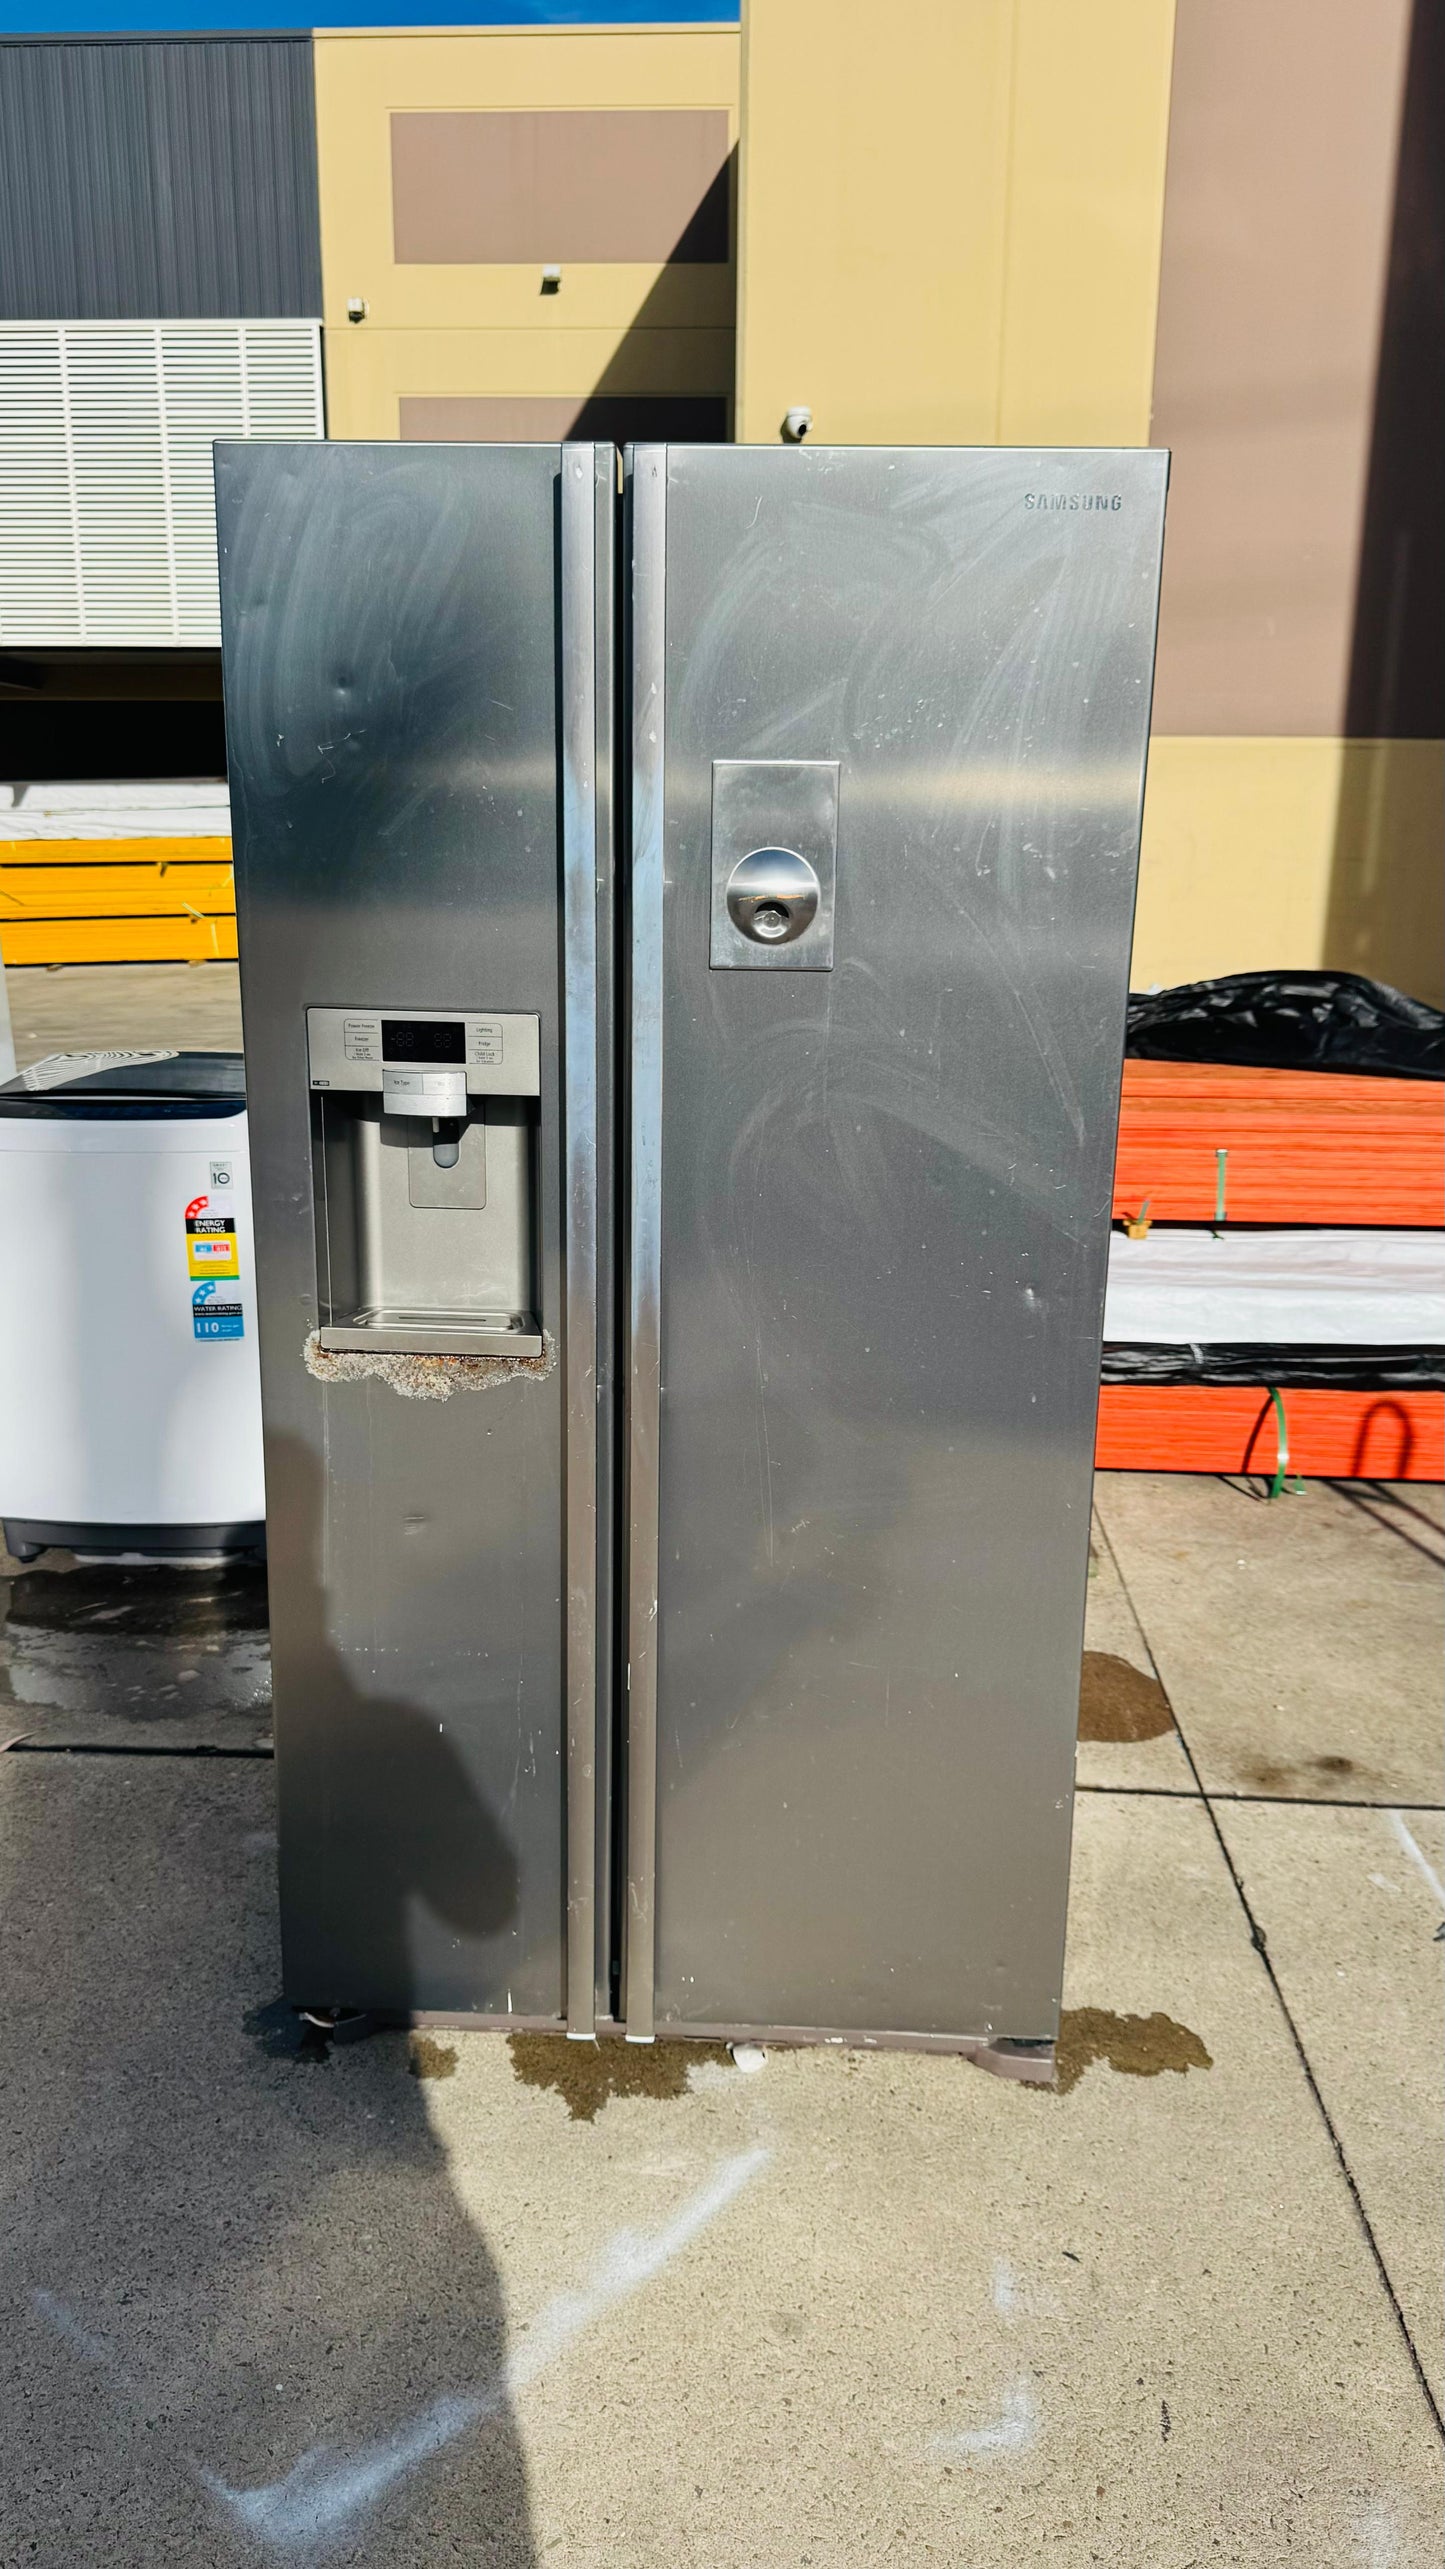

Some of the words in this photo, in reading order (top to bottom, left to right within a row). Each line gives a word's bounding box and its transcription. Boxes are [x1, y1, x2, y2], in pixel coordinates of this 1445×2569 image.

[1024, 493, 1122, 511] SAMSUNG
[194, 1219, 226, 1227] ENERGY
[196, 1321, 219, 1333] 110
